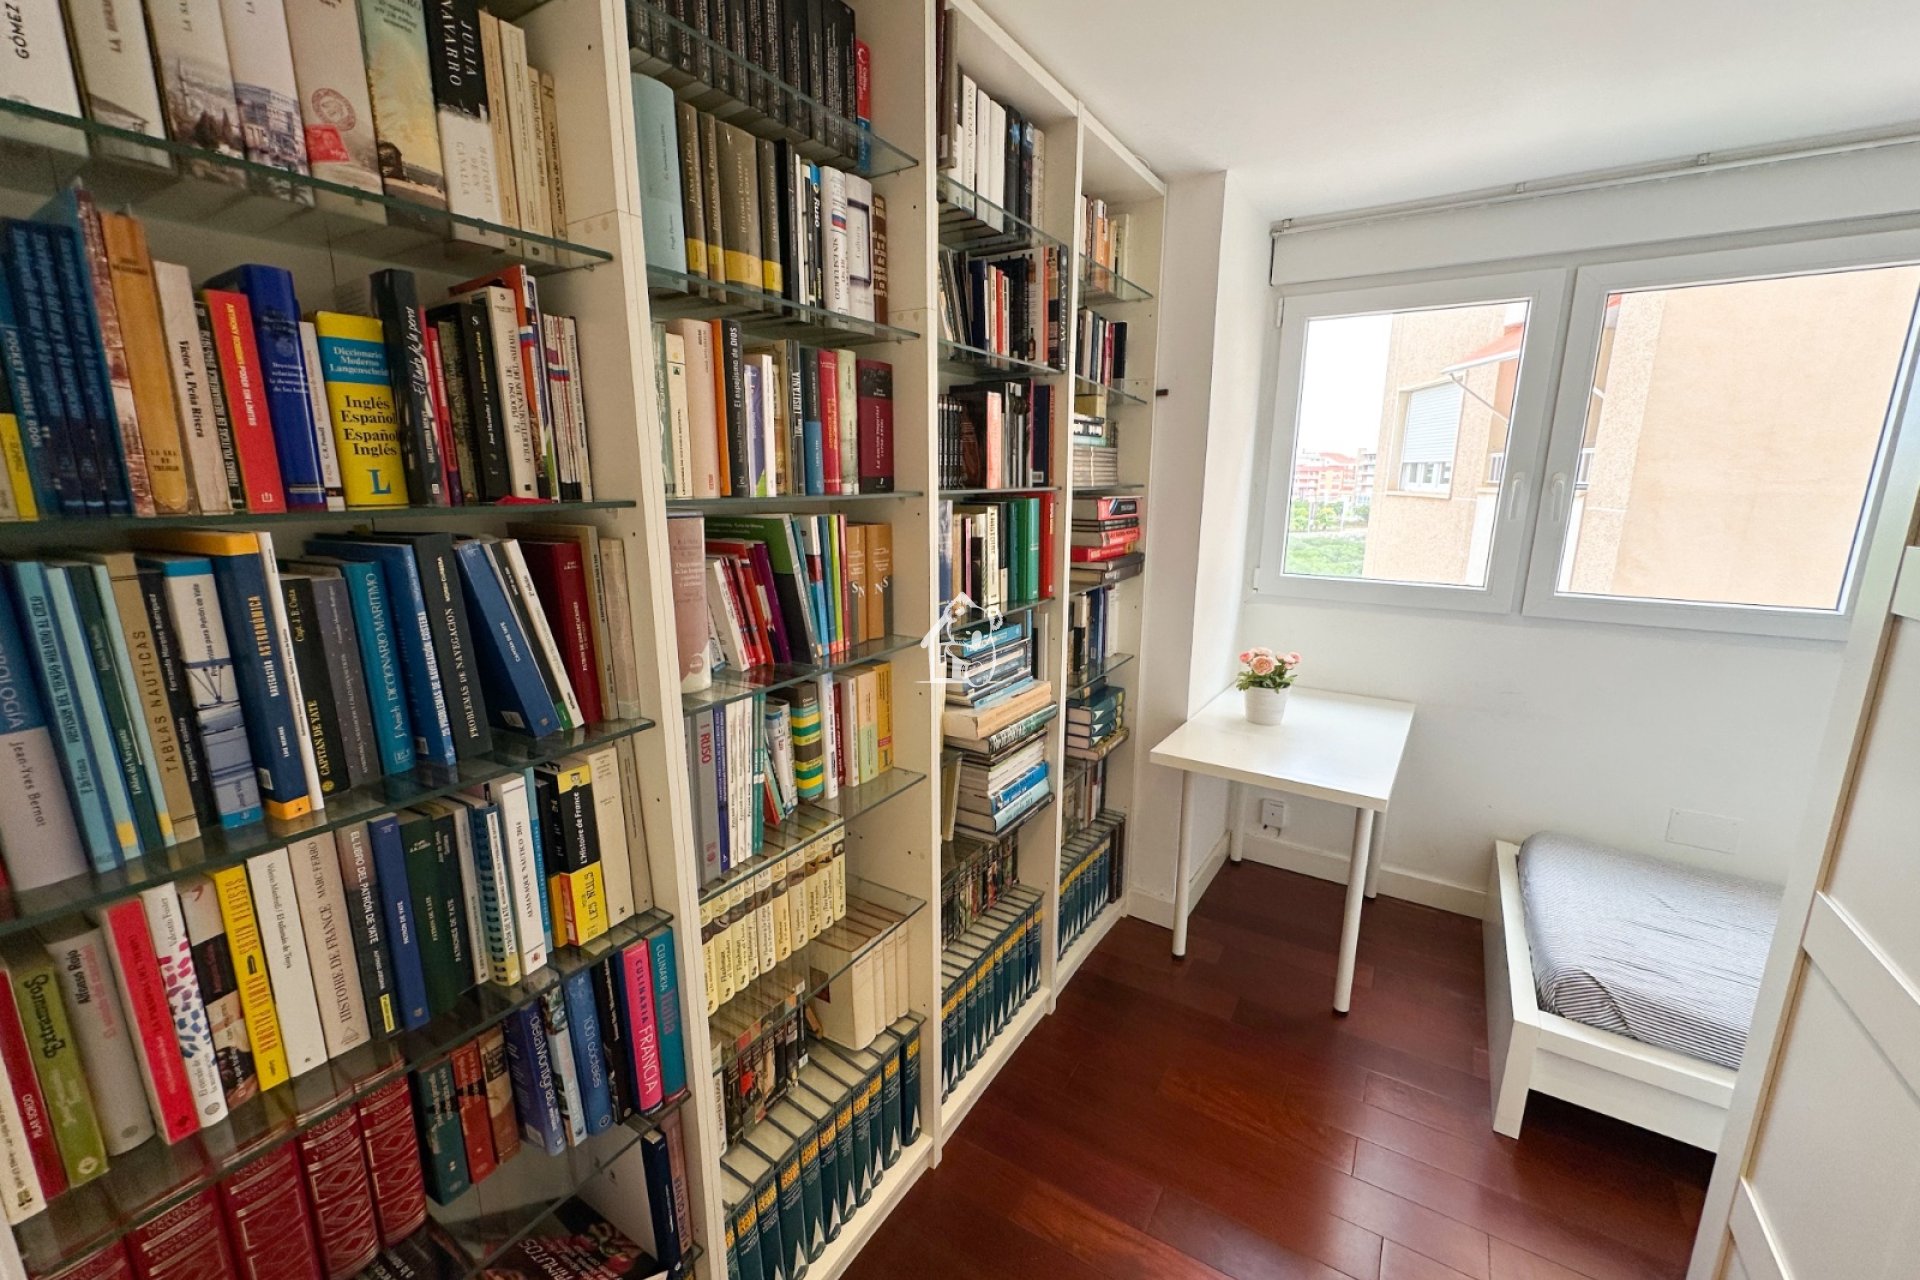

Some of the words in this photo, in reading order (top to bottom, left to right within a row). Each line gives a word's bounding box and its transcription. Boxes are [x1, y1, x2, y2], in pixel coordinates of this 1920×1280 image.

[5, 3, 30, 59] GÓMEZ
[460, 20, 477, 76] JULIA
[730, 327, 739, 347] DIOS
[731, 347, 740, 359] de
[345, 395, 391, 410] Inglés
[733, 400, 742, 408] El
[341, 410, 398, 425] Español
[344, 428, 398, 443] Español
[353, 443, 398, 457] Inglés
[132, 631, 161, 708] NAUTICAS
[458, 671, 468, 682] DE
[307, 700, 320, 722] YATE
[460, 685, 479, 738] PROBLEMAS
[312, 723, 323, 736] DE
[154, 715, 178, 773] TABLAS
[701, 732, 712, 765] RUSO
[8, 741, 33, 790] Jean-Yves
[573, 792, 582, 818] France
[577, 819, 583, 828] de
[308, 841, 322, 872] FERRO
[578, 828, 588, 864] L'Histoire
[313, 873, 327, 898] MARC
[357, 866, 369, 883] DEL
[360, 882, 375, 914] PATRÓN
[364, 914, 376, 925] DE
[588, 902, 599, 920] LES
[319, 903, 338, 950] FRANCE
[368, 925, 379, 944] YATE
[66, 950, 81, 971] Rojo
[326, 950, 342, 969] DE
[656, 943, 668, 991] CULINARIA
[331, 969, 352, 1023] HISTOIRE
[635, 959, 648, 1023] CULINARIA
[638, 1024, 659, 1095] FRANCIA
